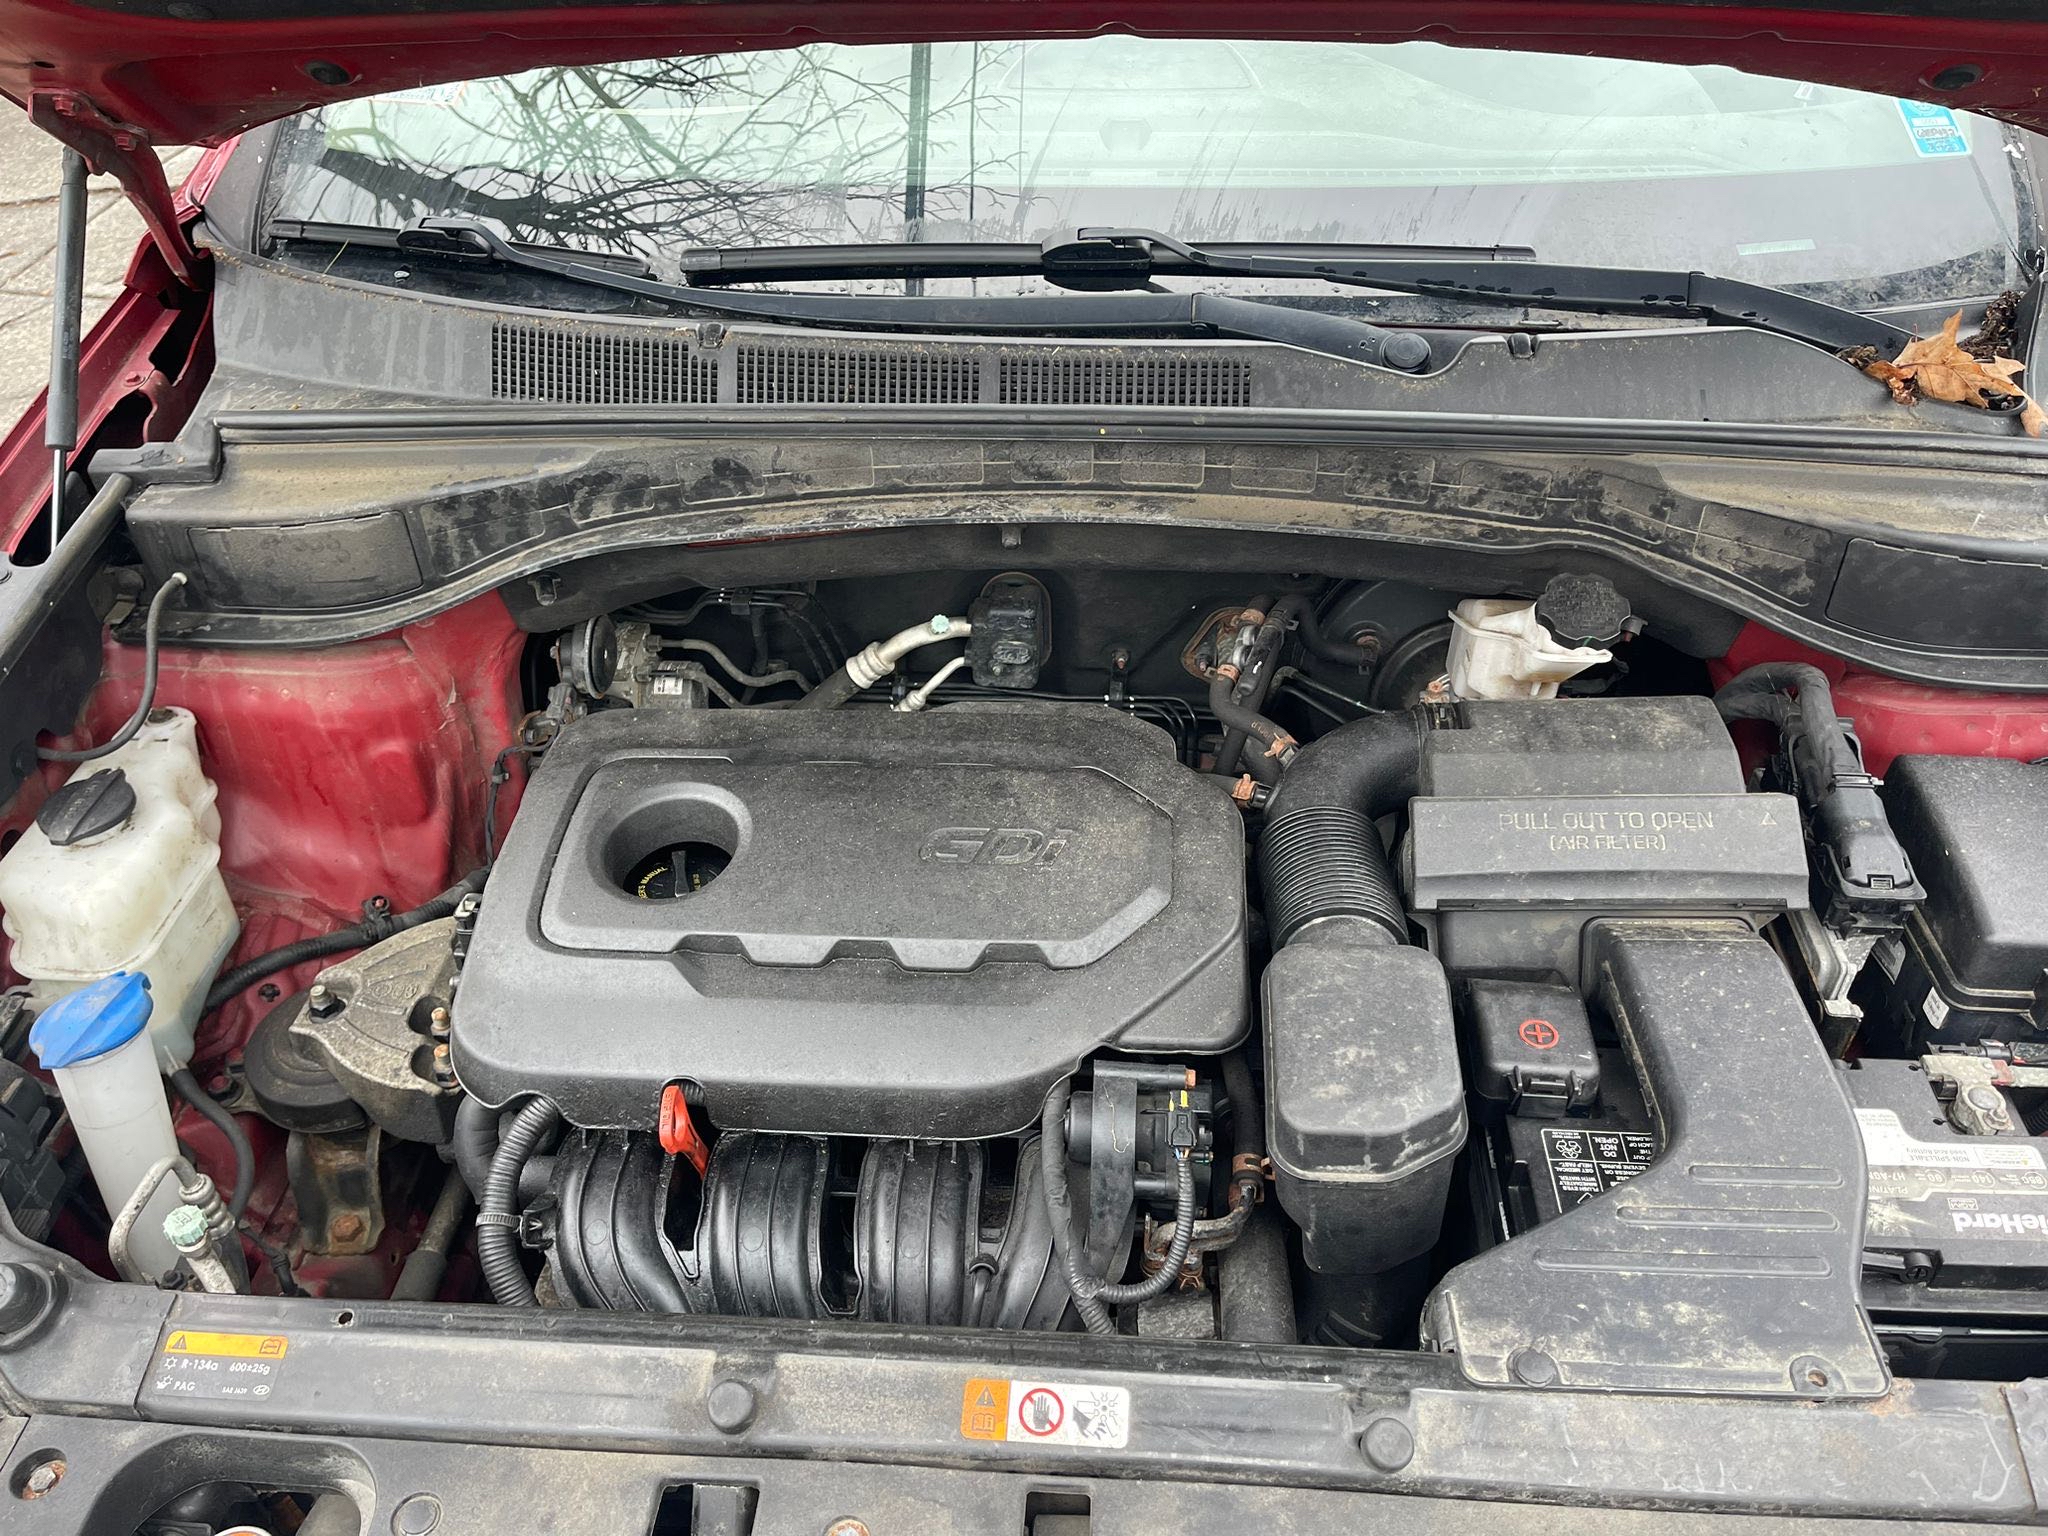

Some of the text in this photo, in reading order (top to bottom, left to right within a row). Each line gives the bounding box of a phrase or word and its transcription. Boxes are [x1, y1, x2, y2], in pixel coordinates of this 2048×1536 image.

[1499, 811, 1714, 831] PULL OUT TO OPEN
[1549, 834, 1667, 851] (AIR FILTER)
[1971, 1174, 1992, 1184] 140
[1868, 1186, 1909, 1194] PLATIN
[1952, 1212, 2048, 1235] ieHard
[180, 1360, 271, 1375] R-134a 600±25g
[173, 1381, 196, 1391] PAG
